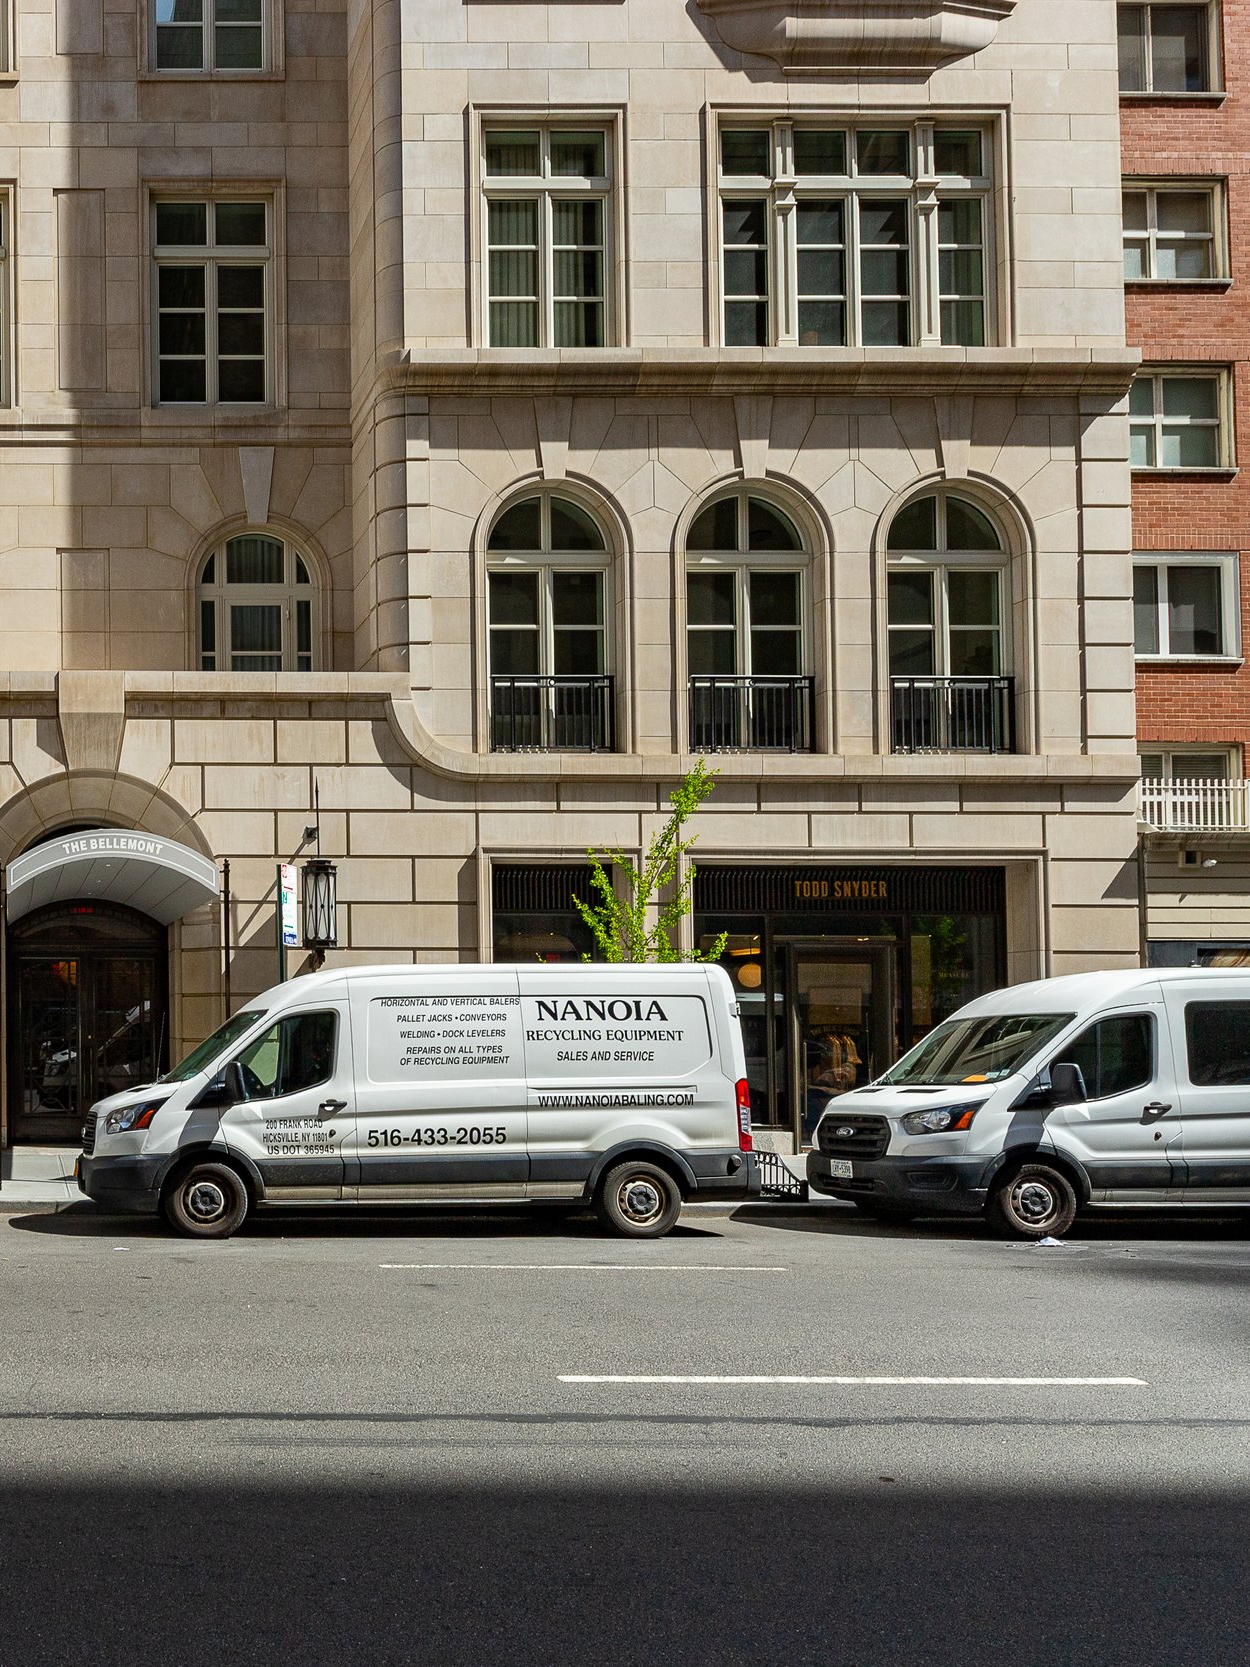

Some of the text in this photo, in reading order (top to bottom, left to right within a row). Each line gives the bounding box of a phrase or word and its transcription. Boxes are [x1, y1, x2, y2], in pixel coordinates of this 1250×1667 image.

[62, 838, 163, 855] THE BELLEMONT
[794, 880, 887, 897] TODD SNYDER
[381, 997, 520, 1007] HORIZONTAL AND VERTICAL BALERS
[535, 1000, 668, 1021] NANOIA
[396, 1013, 507, 1023] PALLET JACKS CONVEYORS
[399, 1029, 506, 1039] WELDING DOCK LEVELERS
[526, 1029, 684, 1042] RECYCLING EQUIPMENT
[406, 1045, 503, 1055] REPAIRS ON ALL TYPES
[557, 1050, 654, 1061] SALES AND SERVICE
[400, 1056, 510, 1066] OF RECYCLING EQUIPMENT
[538, 1094, 694, 1108] WWW.NANOIABALING.COM
[265, 1118, 323, 1130] 200 FRANK ROAD
[262, 1132, 328, 1144] HICKSVILLE, NY 11801
[367, 1127, 507, 1148] 516-433-2055
[267, 1144, 335, 1155] US DOT 365945
